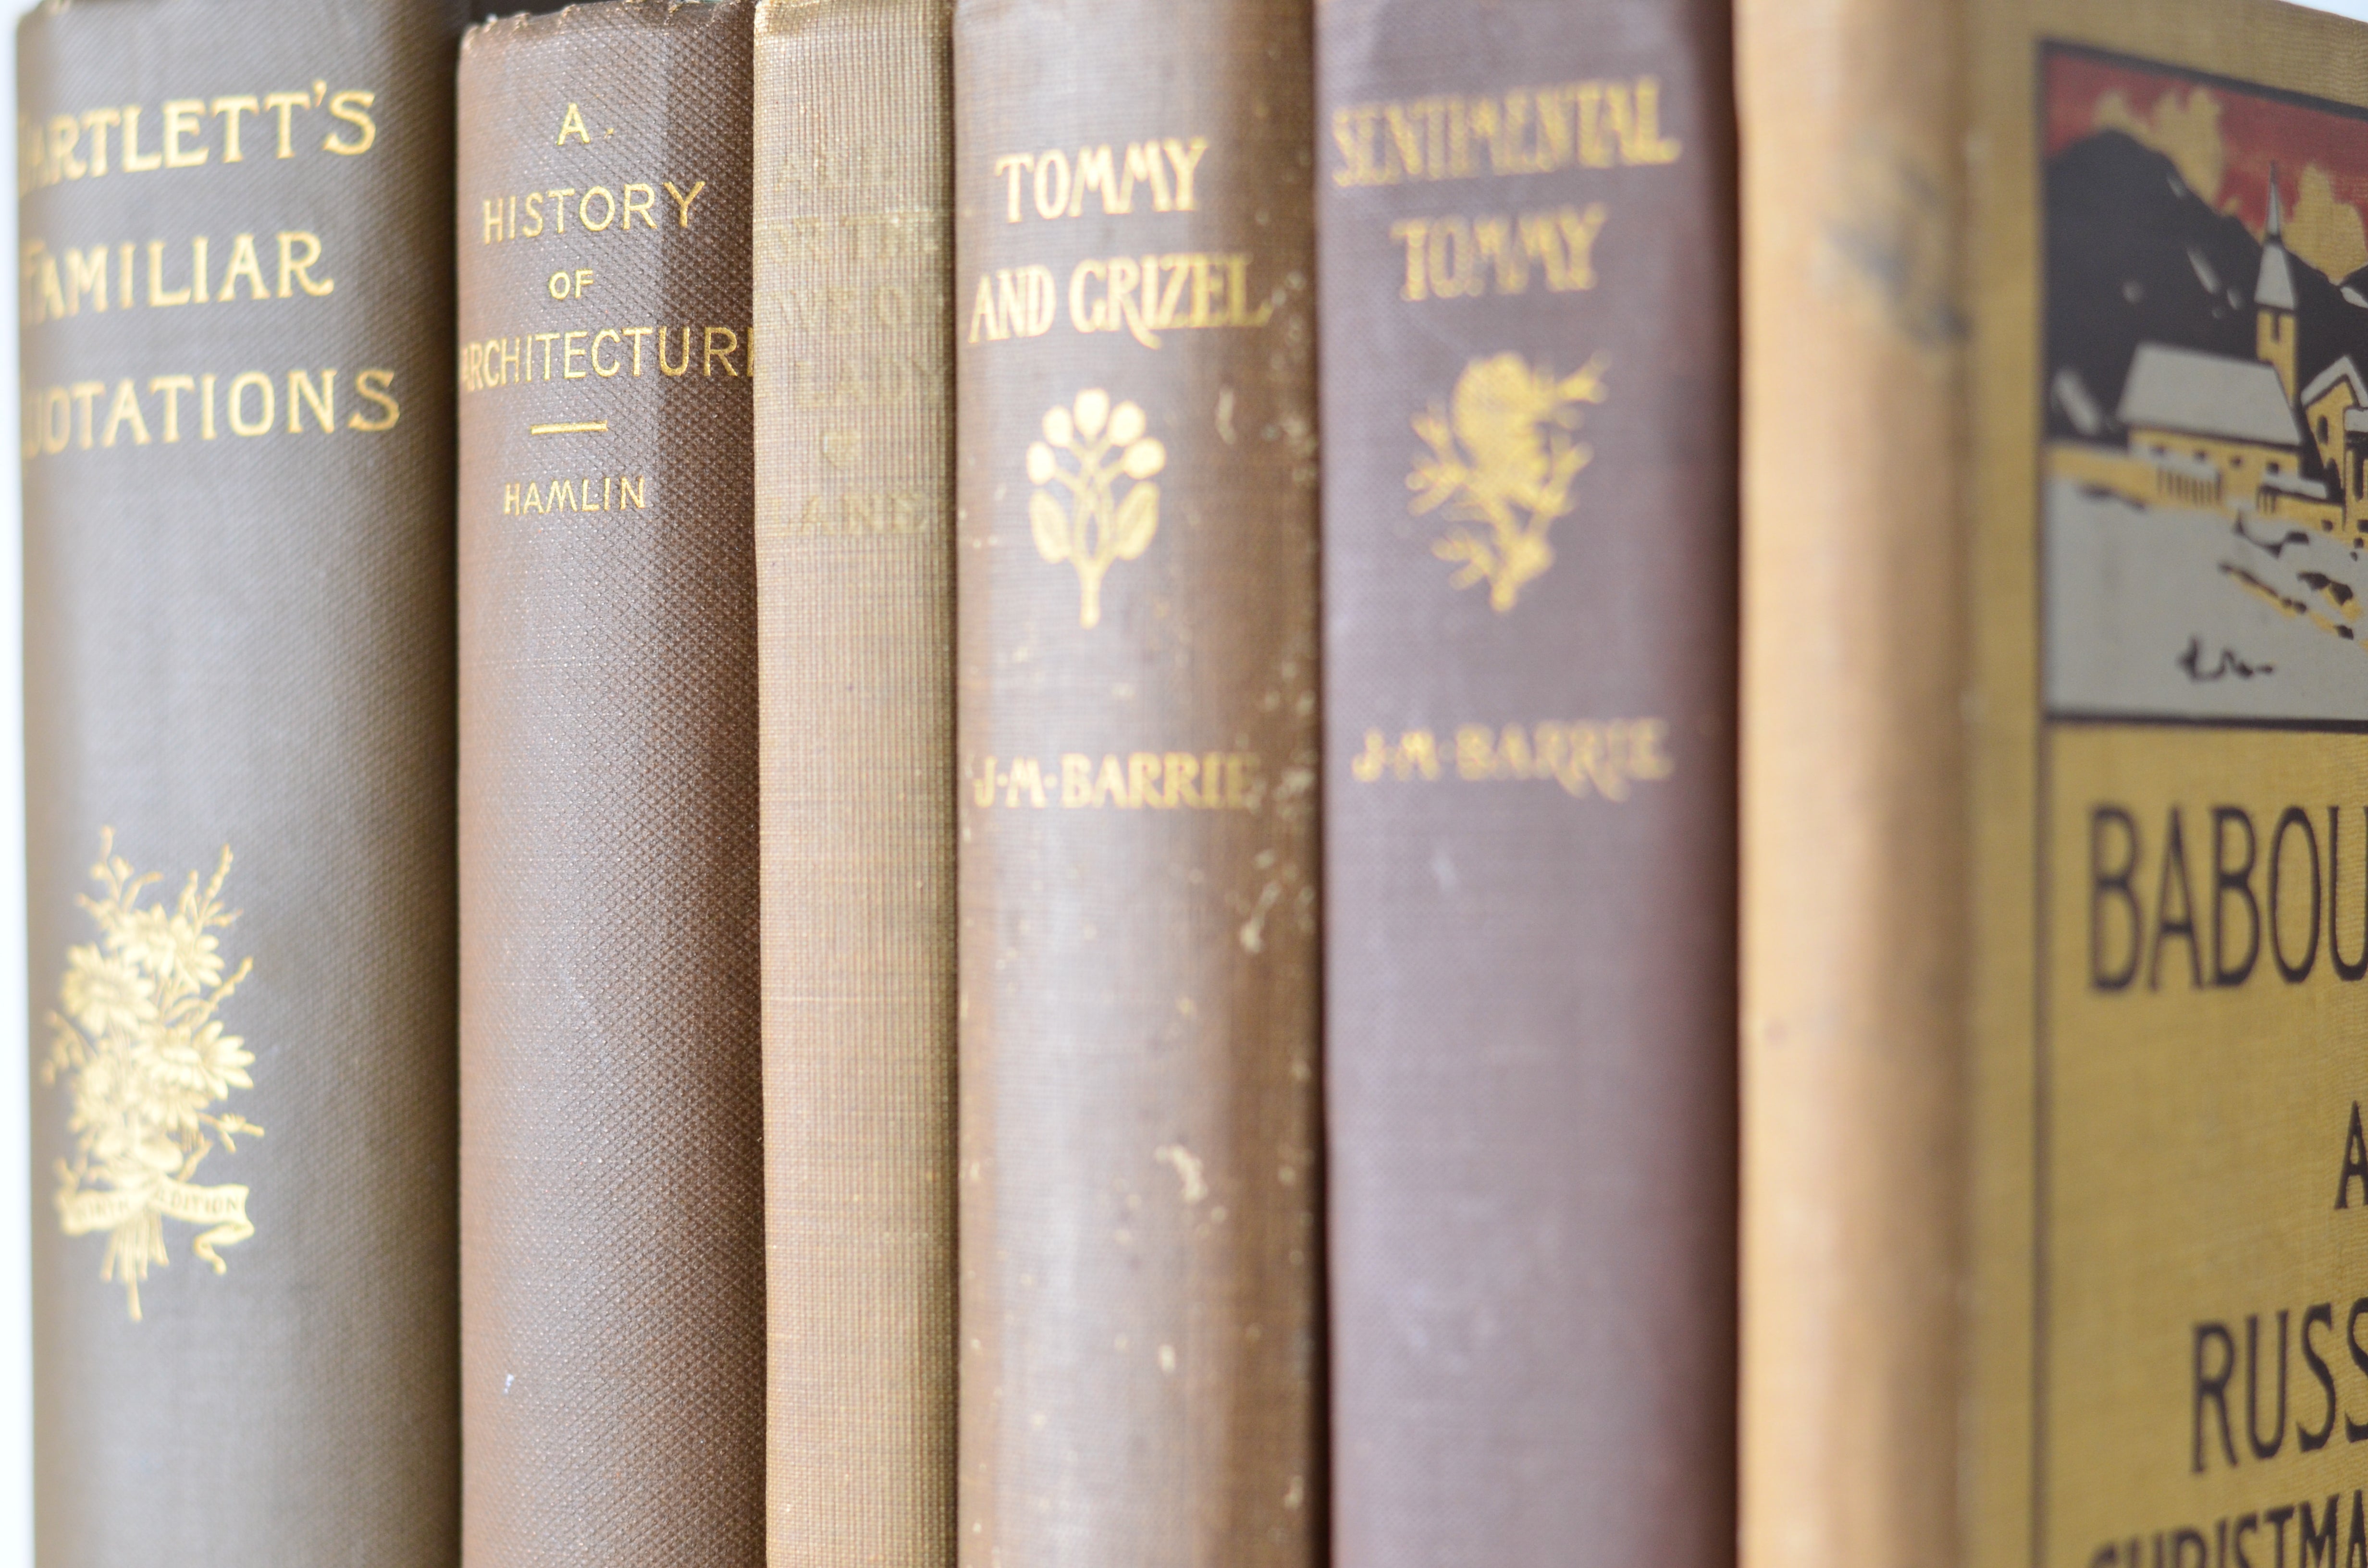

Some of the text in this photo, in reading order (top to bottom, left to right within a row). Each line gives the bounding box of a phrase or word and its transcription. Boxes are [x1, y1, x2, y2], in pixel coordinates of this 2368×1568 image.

[20, 79, 377, 196] ARTLETT'S
[557, 102, 590, 146] A
[483, 181, 705, 244] HISTORY
[995, 136, 1209, 223] TOMMY
[20, 231, 335, 327] FAMILIAR
[549, 269, 593, 300] OF
[1389, 201, 1611, 302] TOMMY
[967, 263, 1057, 344] AND
[1068, 252, 1274, 350] GRIZEL
[22, 368, 401, 460] UOTATIONS
[504, 477, 645, 516] HAMLIN
[2088, 802, 2368, 993] BABOU
[2334, 1099, 2368, 1209] A
